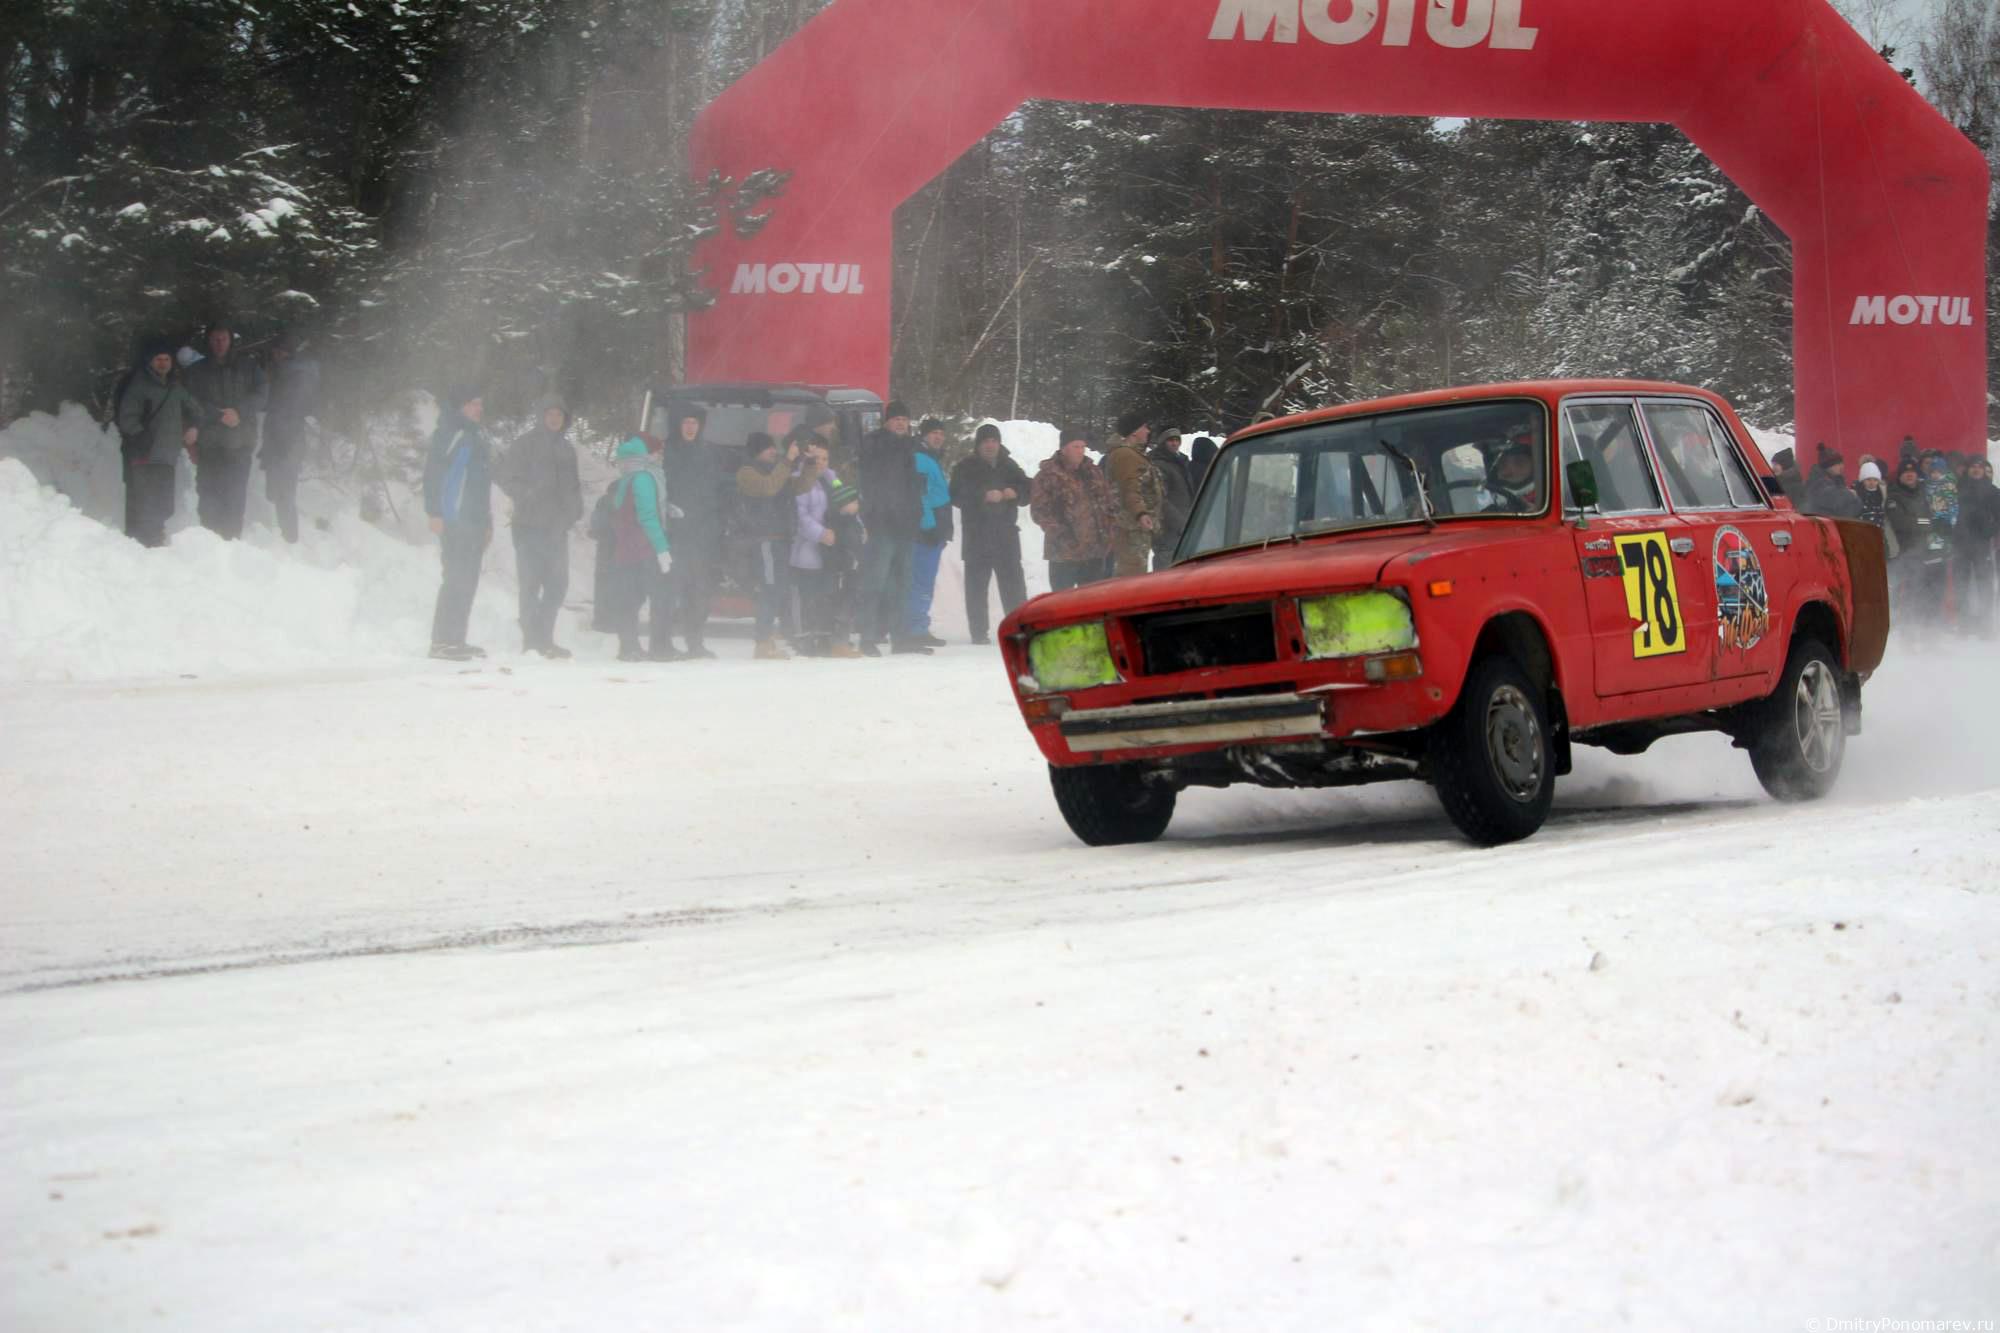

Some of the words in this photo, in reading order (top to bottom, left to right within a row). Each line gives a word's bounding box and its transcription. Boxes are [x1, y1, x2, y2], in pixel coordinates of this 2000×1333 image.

[730, 262, 864, 294] MOTUL
[1848, 294, 1973, 325] MOTUL
[1621, 539, 1678, 648] 78
